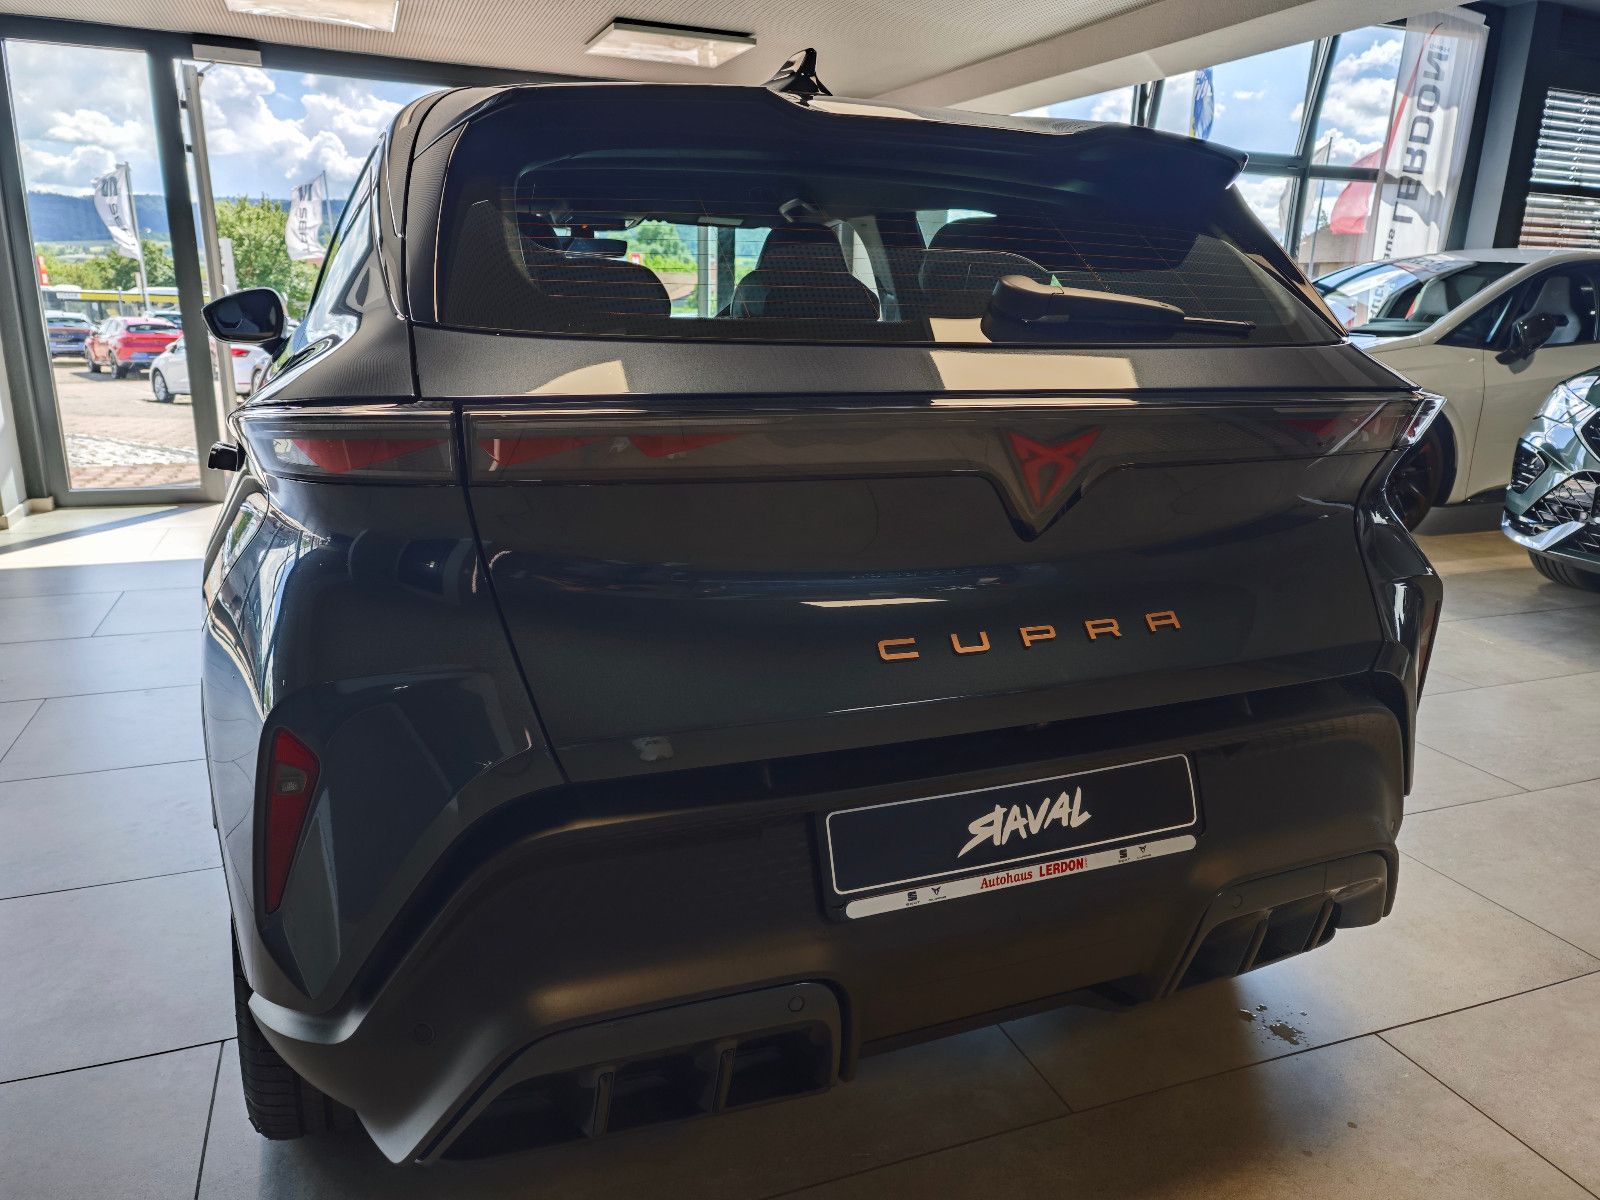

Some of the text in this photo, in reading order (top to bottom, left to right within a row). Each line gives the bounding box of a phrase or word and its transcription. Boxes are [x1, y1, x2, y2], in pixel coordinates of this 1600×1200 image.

[877, 610, 1182, 661] CUPRA
[980, 870, 1034, 890] Autohaus
[1039, 857, 1084, 878] LERDON
